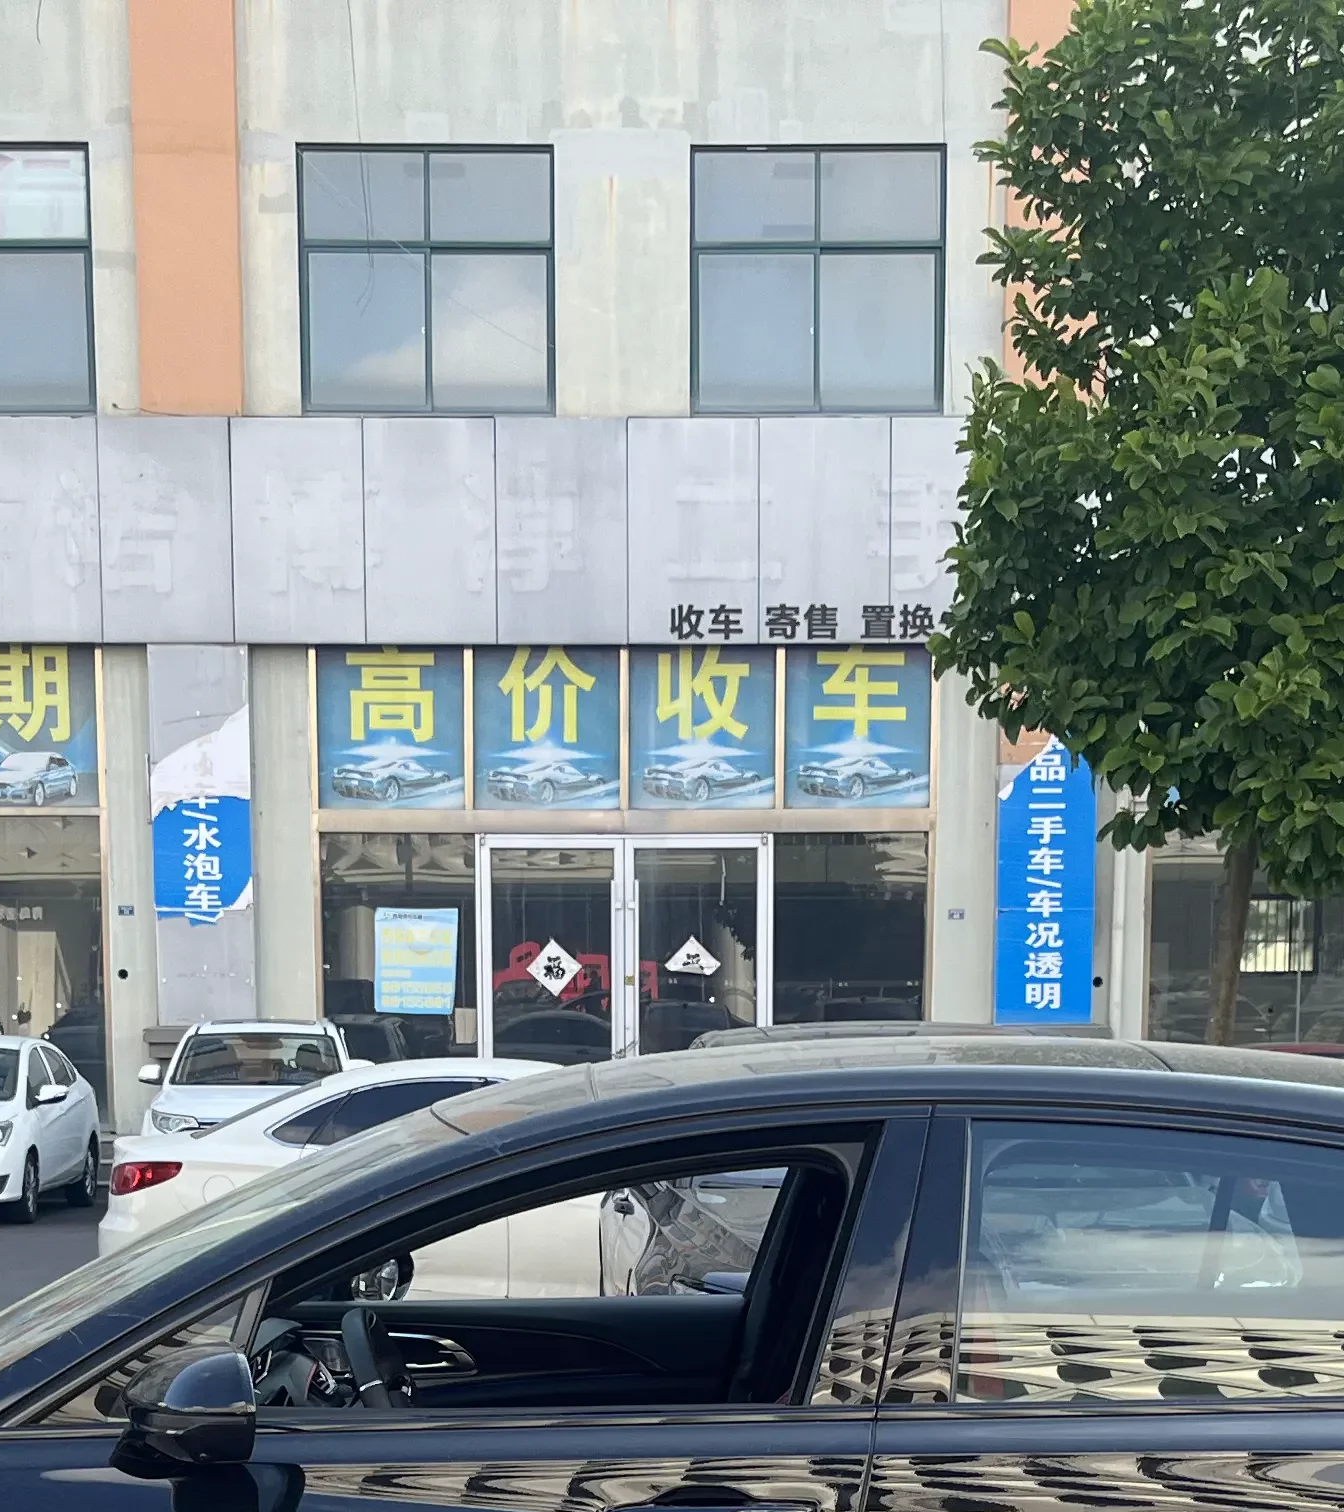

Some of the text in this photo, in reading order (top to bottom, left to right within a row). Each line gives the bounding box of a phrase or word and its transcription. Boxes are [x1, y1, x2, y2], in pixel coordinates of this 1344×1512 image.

[670, 604, 743, 640] 收车
[765, 604, 838, 640] 寄售
[1024, 739, 1067, 1011] 品二手车/车况透明
